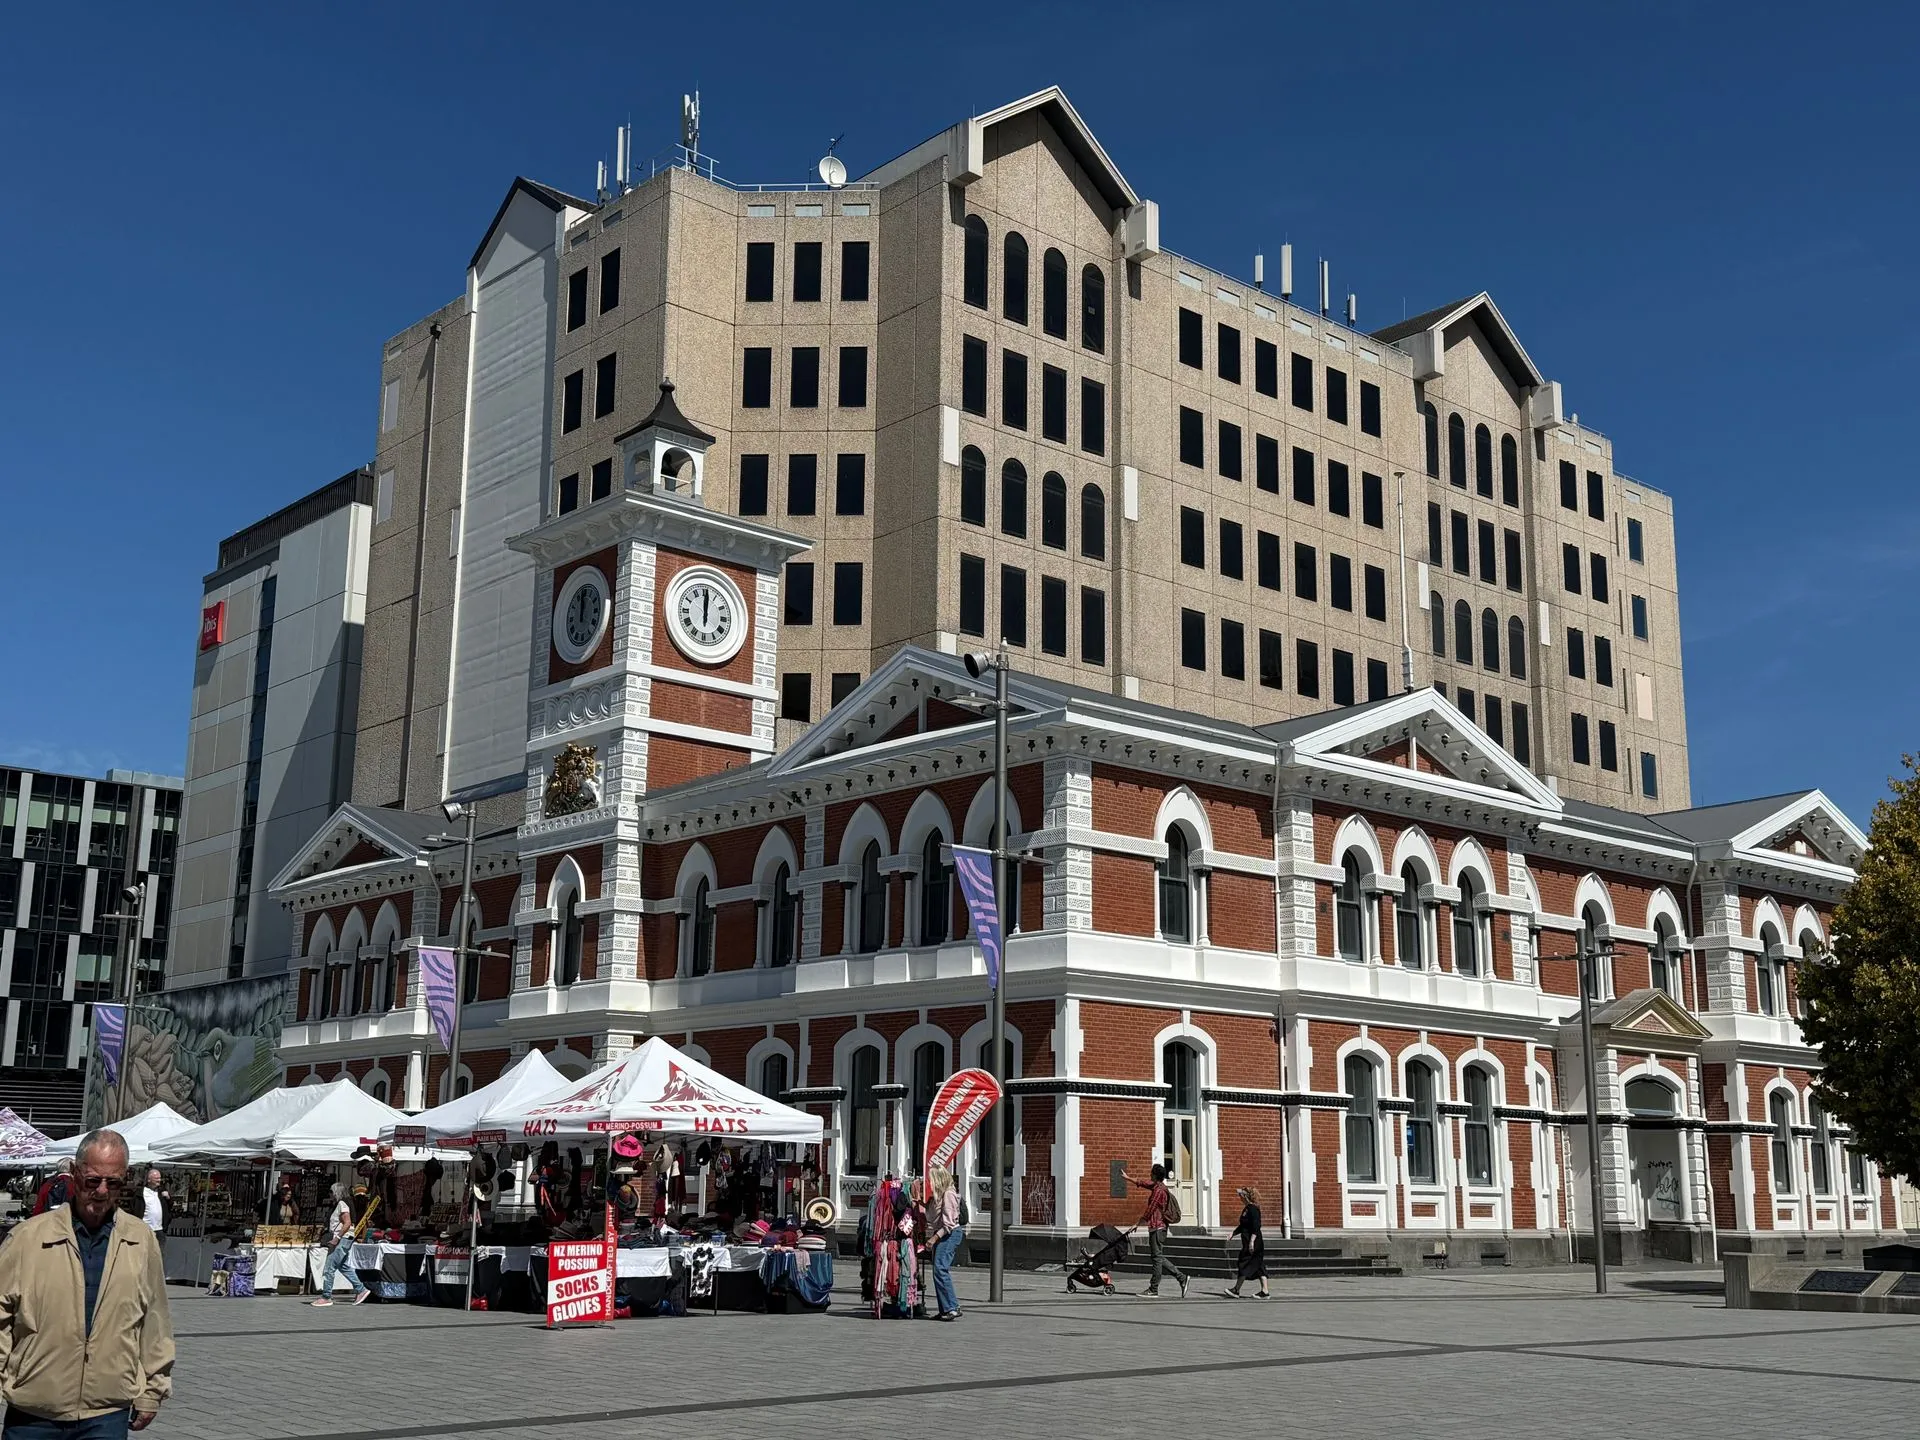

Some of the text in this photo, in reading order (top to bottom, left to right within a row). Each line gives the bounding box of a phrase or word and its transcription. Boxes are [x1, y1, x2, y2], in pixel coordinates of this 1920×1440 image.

[204, 615, 217, 633] ibis
[649, 1103, 770, 1115] RED ROCK
[933, 1077, 976, 1129] THE ORIGINAL
[523, 1119, 558, 1137] HATS
[605, 1121, 658, 1131] MERINO-POSSUM
[694, 1117, 749, 1133] HATS
[607, 1231, 615, 1243] BY
[452, 1246, 470, 1255] LOCAL
[554, 1244, 603, 1257] NZ MERINO
[558, 1258, 598, 1271] POSSUM
[555, 1275, 599, 1299] SOCKS
[604, 1246, 614, 1316] HANDCRAFTED
[552, 1296, 601, 1322] GLOVES
